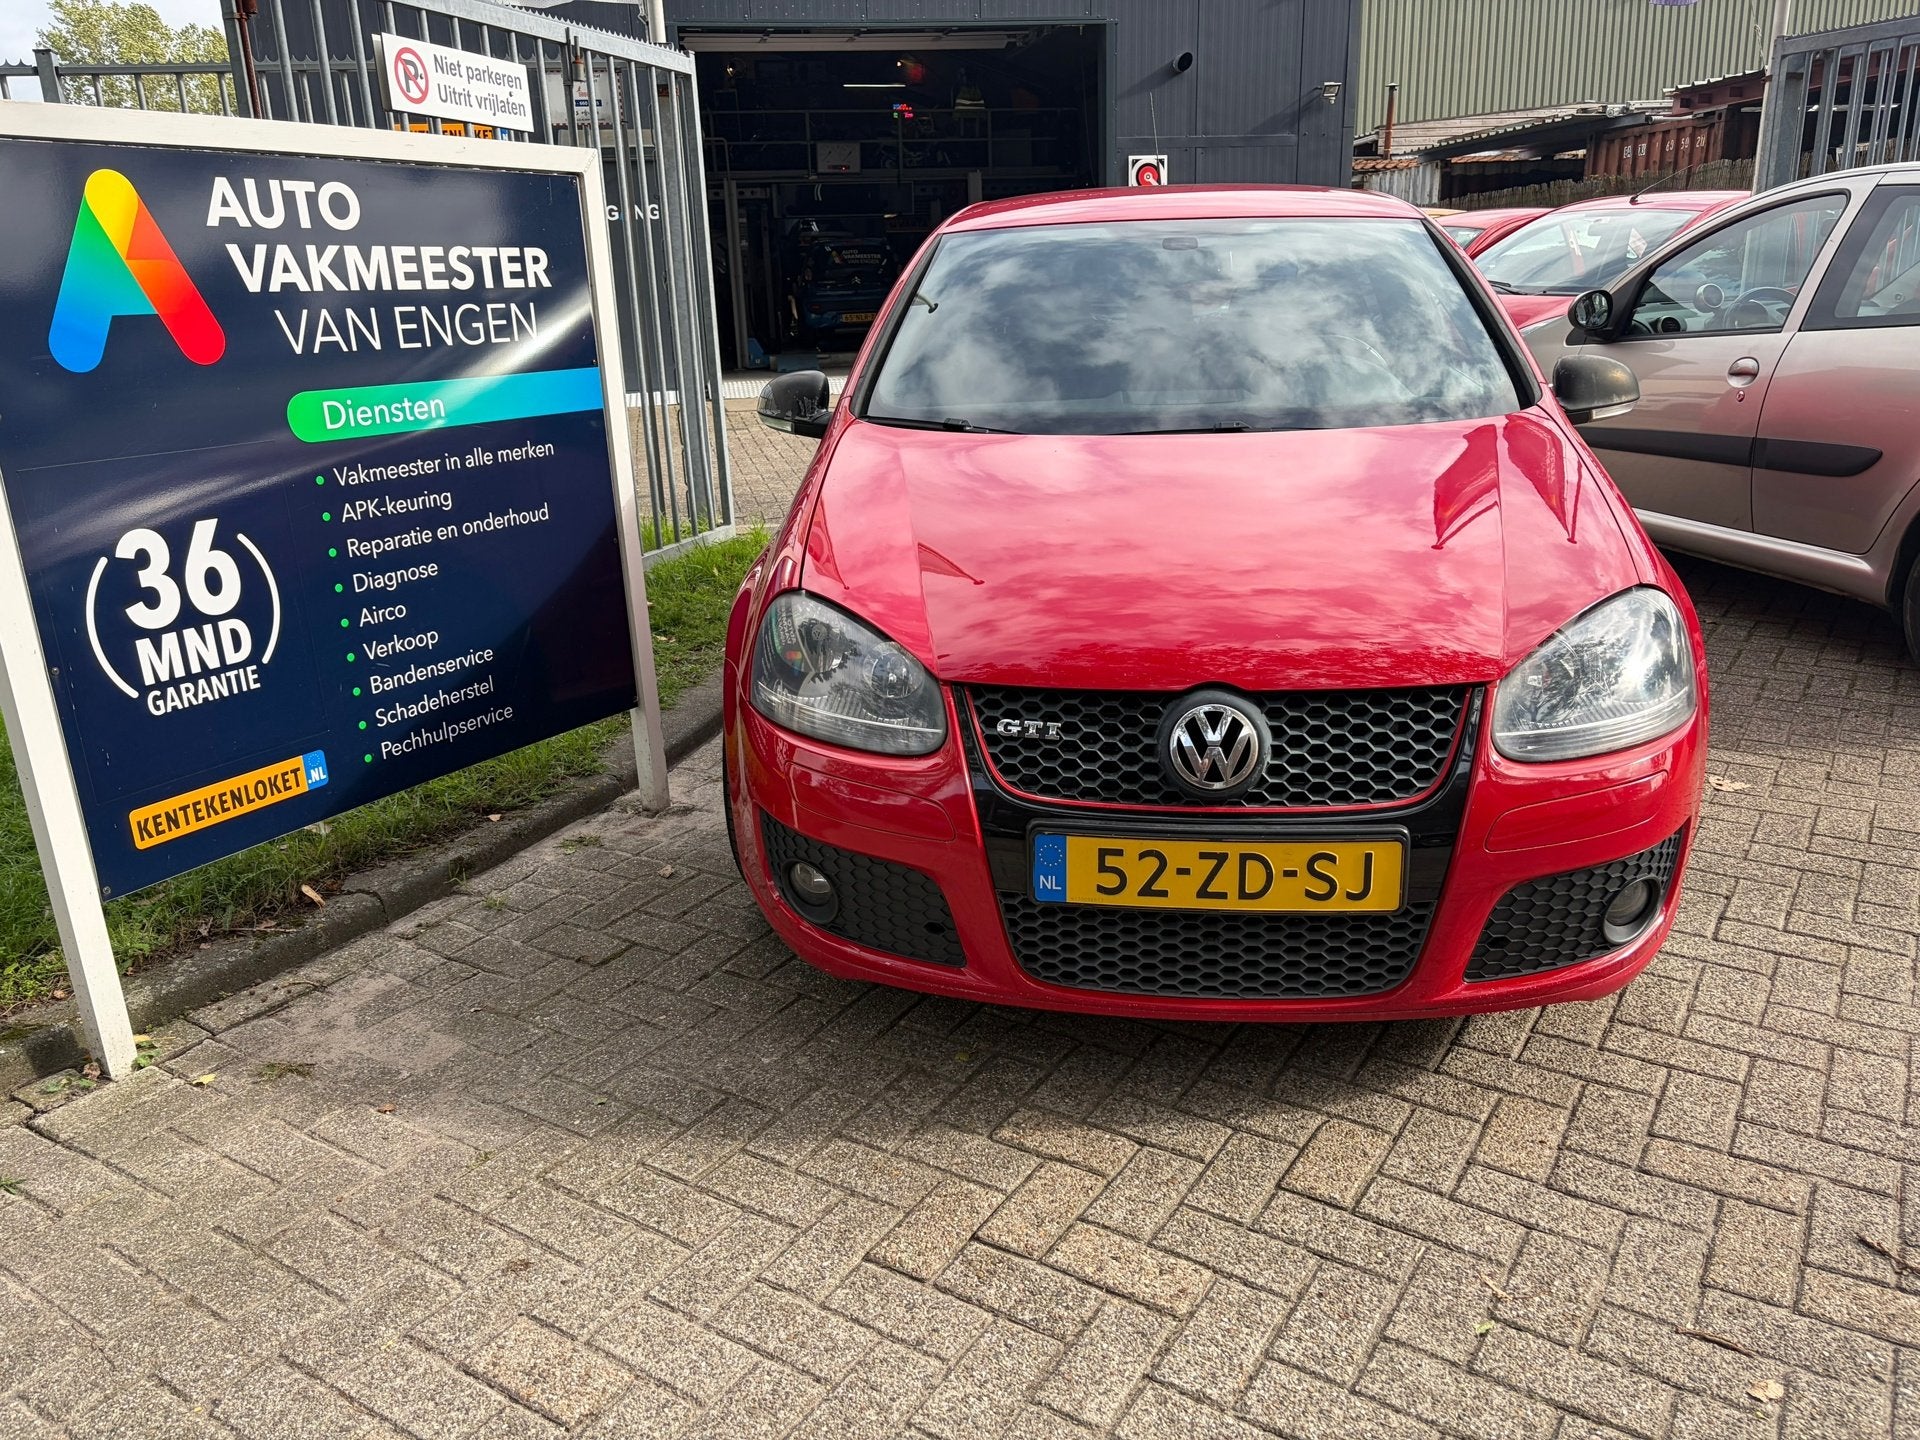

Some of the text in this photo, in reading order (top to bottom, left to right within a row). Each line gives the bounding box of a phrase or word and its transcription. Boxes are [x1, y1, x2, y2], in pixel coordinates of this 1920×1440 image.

[433, 53, 522, 90] Niet parkeren
[437, 83, 526, 117] Uitrit vrijlaten
[206, 176, 361, 231] AUTO
[606, 203, 660, 221] GNG
[225, 243, 552, 293] VAKMEESTER
[274, 302, 538, 355] VAN ENGEN
[322, 398, 445, 430] Diensten
[333, 440, 554, 486] Vakmeester in alle merken
[342, 491, 452, 523] APK-keuring
[347, 502, 549, 559] Reparatie en onderhoud
[115, 518, 241, 629] 36
[352, 562, 438, 593] Diagnose
[359, 604, 407, 627] Airco
[135, 618, 252, 686] MND
[362, 630, 439, 660] Verkoop
[147, 665, 261, 716] GARANTIE
[369, 648, 494, 694] Bandenservice
[375, 675, 494, 727] Schadeherstel
[381, 705, 513, 760] Pechhulpservice
[996, 718, 1062, 741] GTI
[136, 766, 301, 842] KENTEKENLOKET
[1039, 847, 1375, 901] NL 52-ZD-SJ
